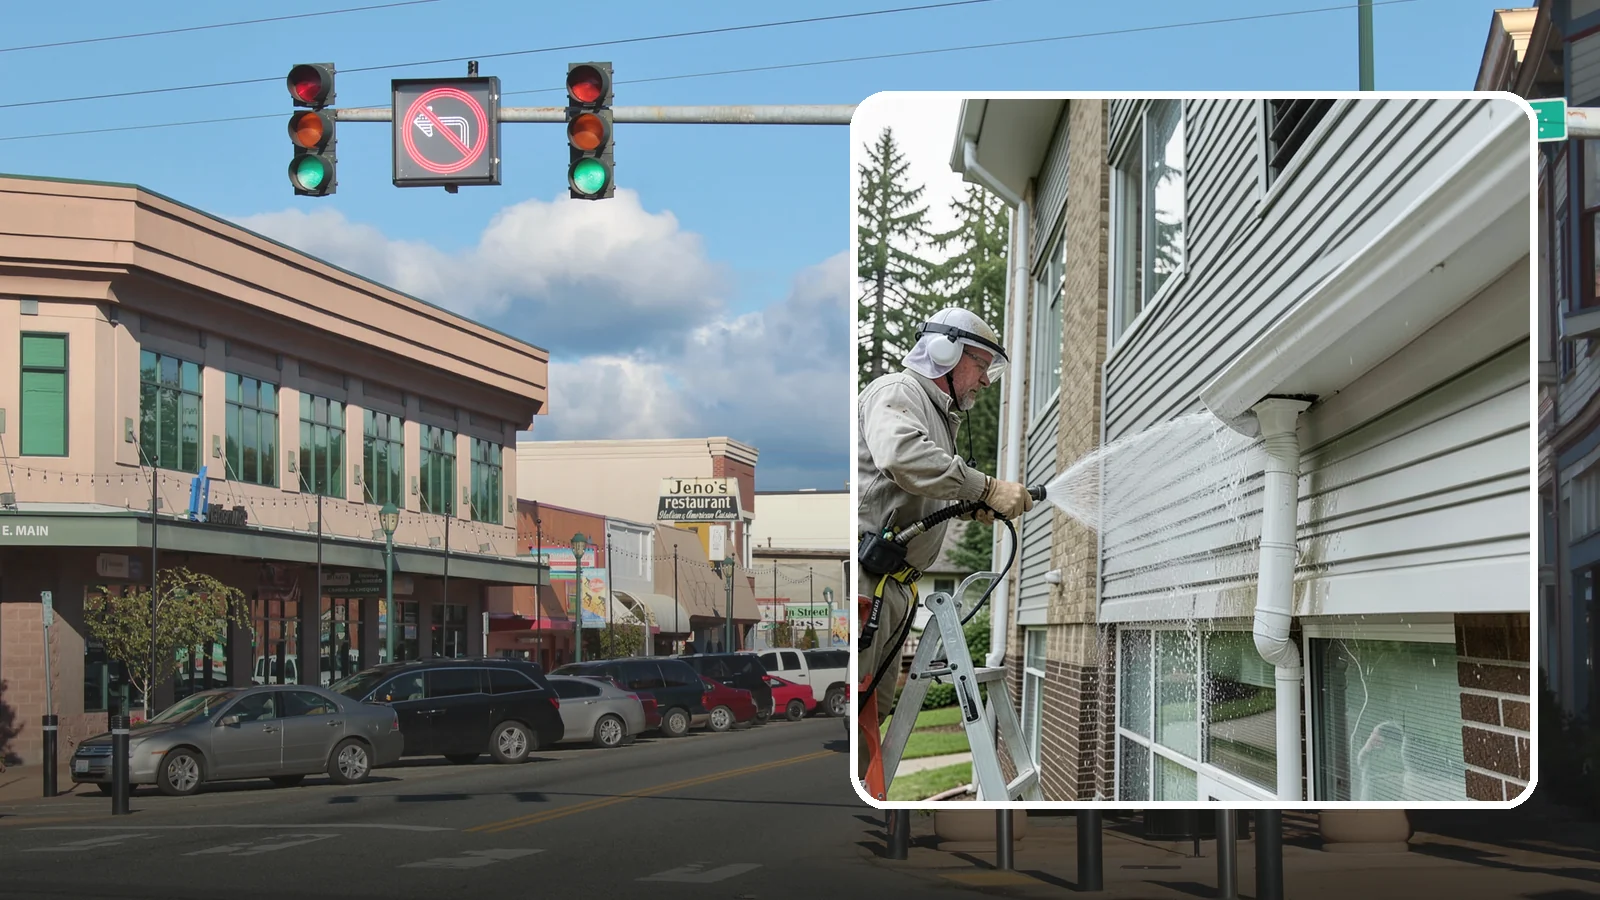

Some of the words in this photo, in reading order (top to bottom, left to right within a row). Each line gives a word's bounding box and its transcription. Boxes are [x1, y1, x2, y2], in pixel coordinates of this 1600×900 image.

[669, 480, 728, 494] Jeno's
[665, 497, 731, 509] restaurant
[658, 510, 681, 520] Italian
[686, 510, 714, 519] American
[715, 510, 737, 519] Cuisine
[2, 525, 13, 536] E.
[15, 525, 49, 536] MAIN
[797, 607, 828, 617] Street
[790, 619, 823, 627] lass
